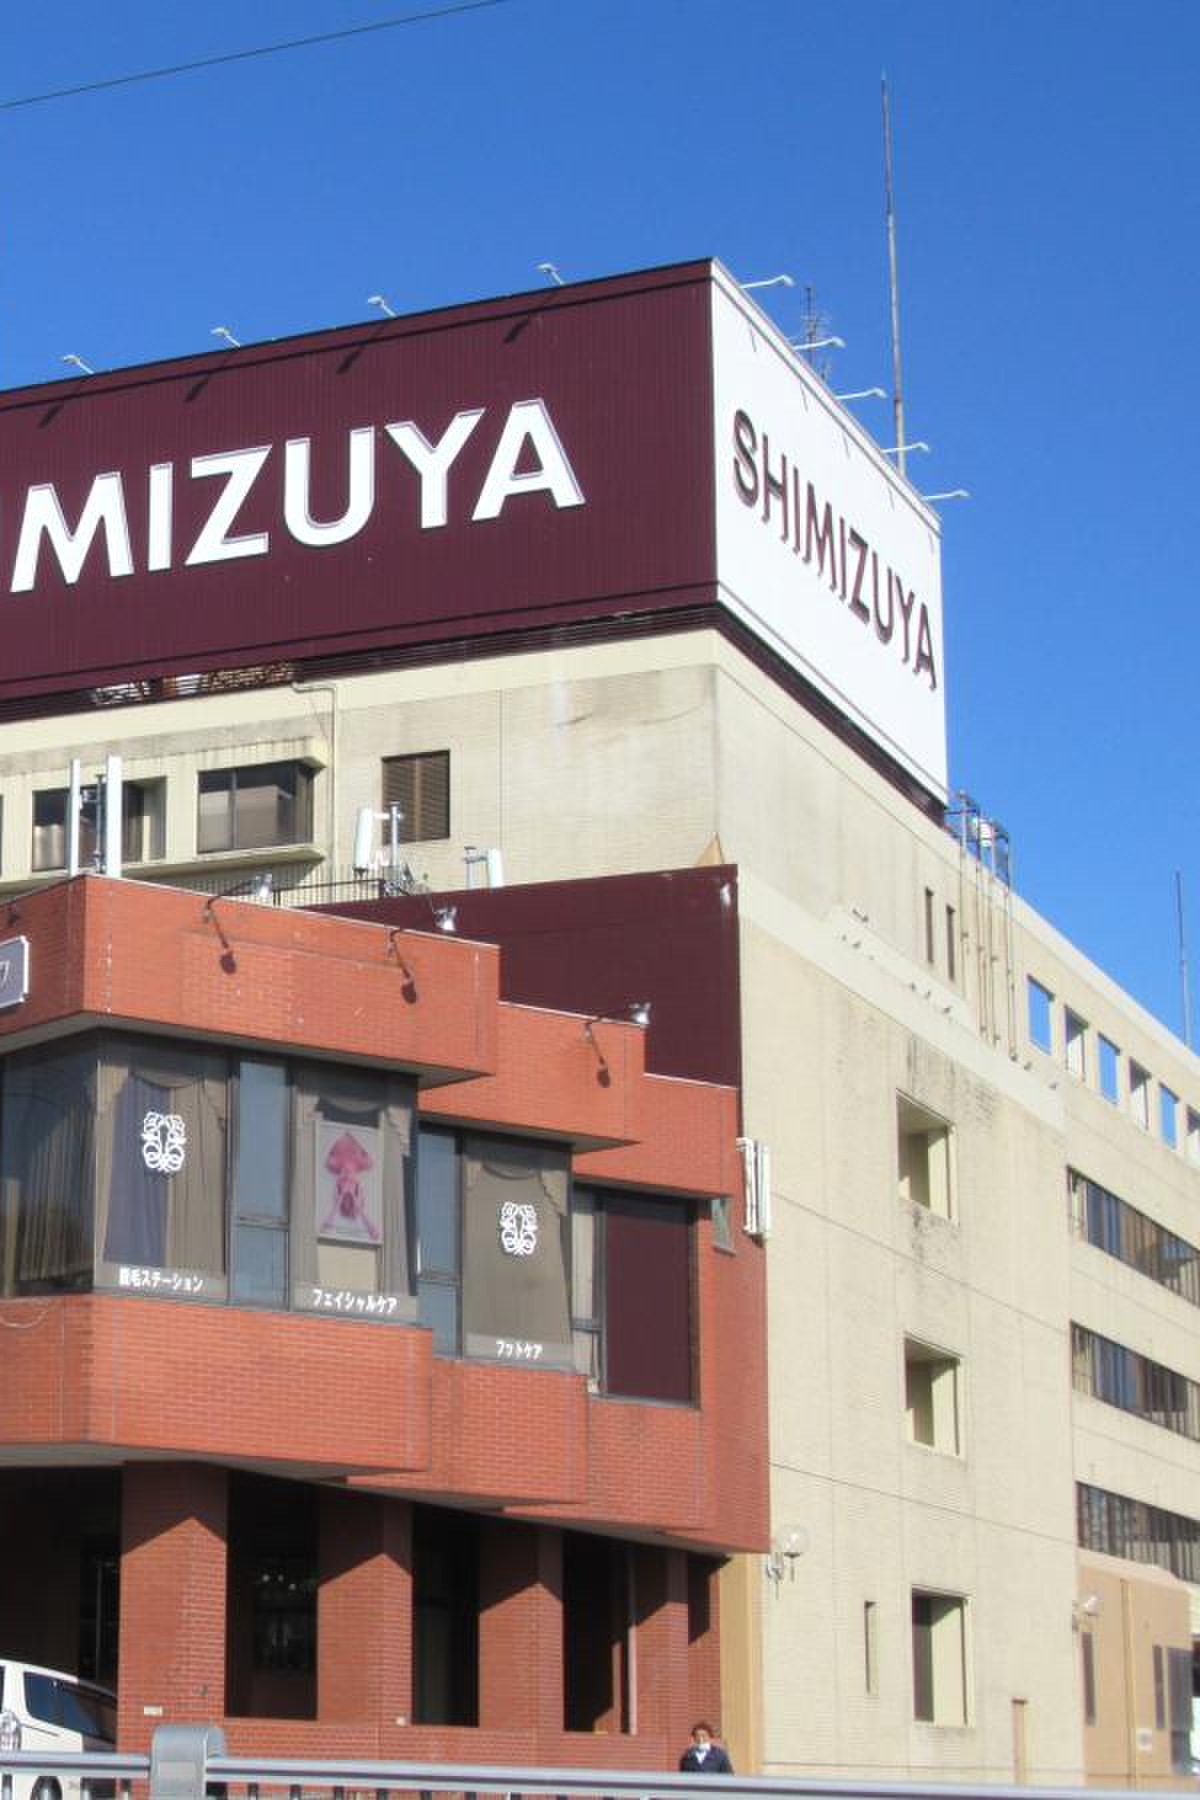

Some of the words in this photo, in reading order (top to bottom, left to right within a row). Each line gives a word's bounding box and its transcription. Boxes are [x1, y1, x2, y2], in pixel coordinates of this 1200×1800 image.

[733, 409, 937, 691] SHIMIZUYA
[312, 1288, 398, 1314] フェイシャルケア
[495, 1339, 544, 1361] フットケア
